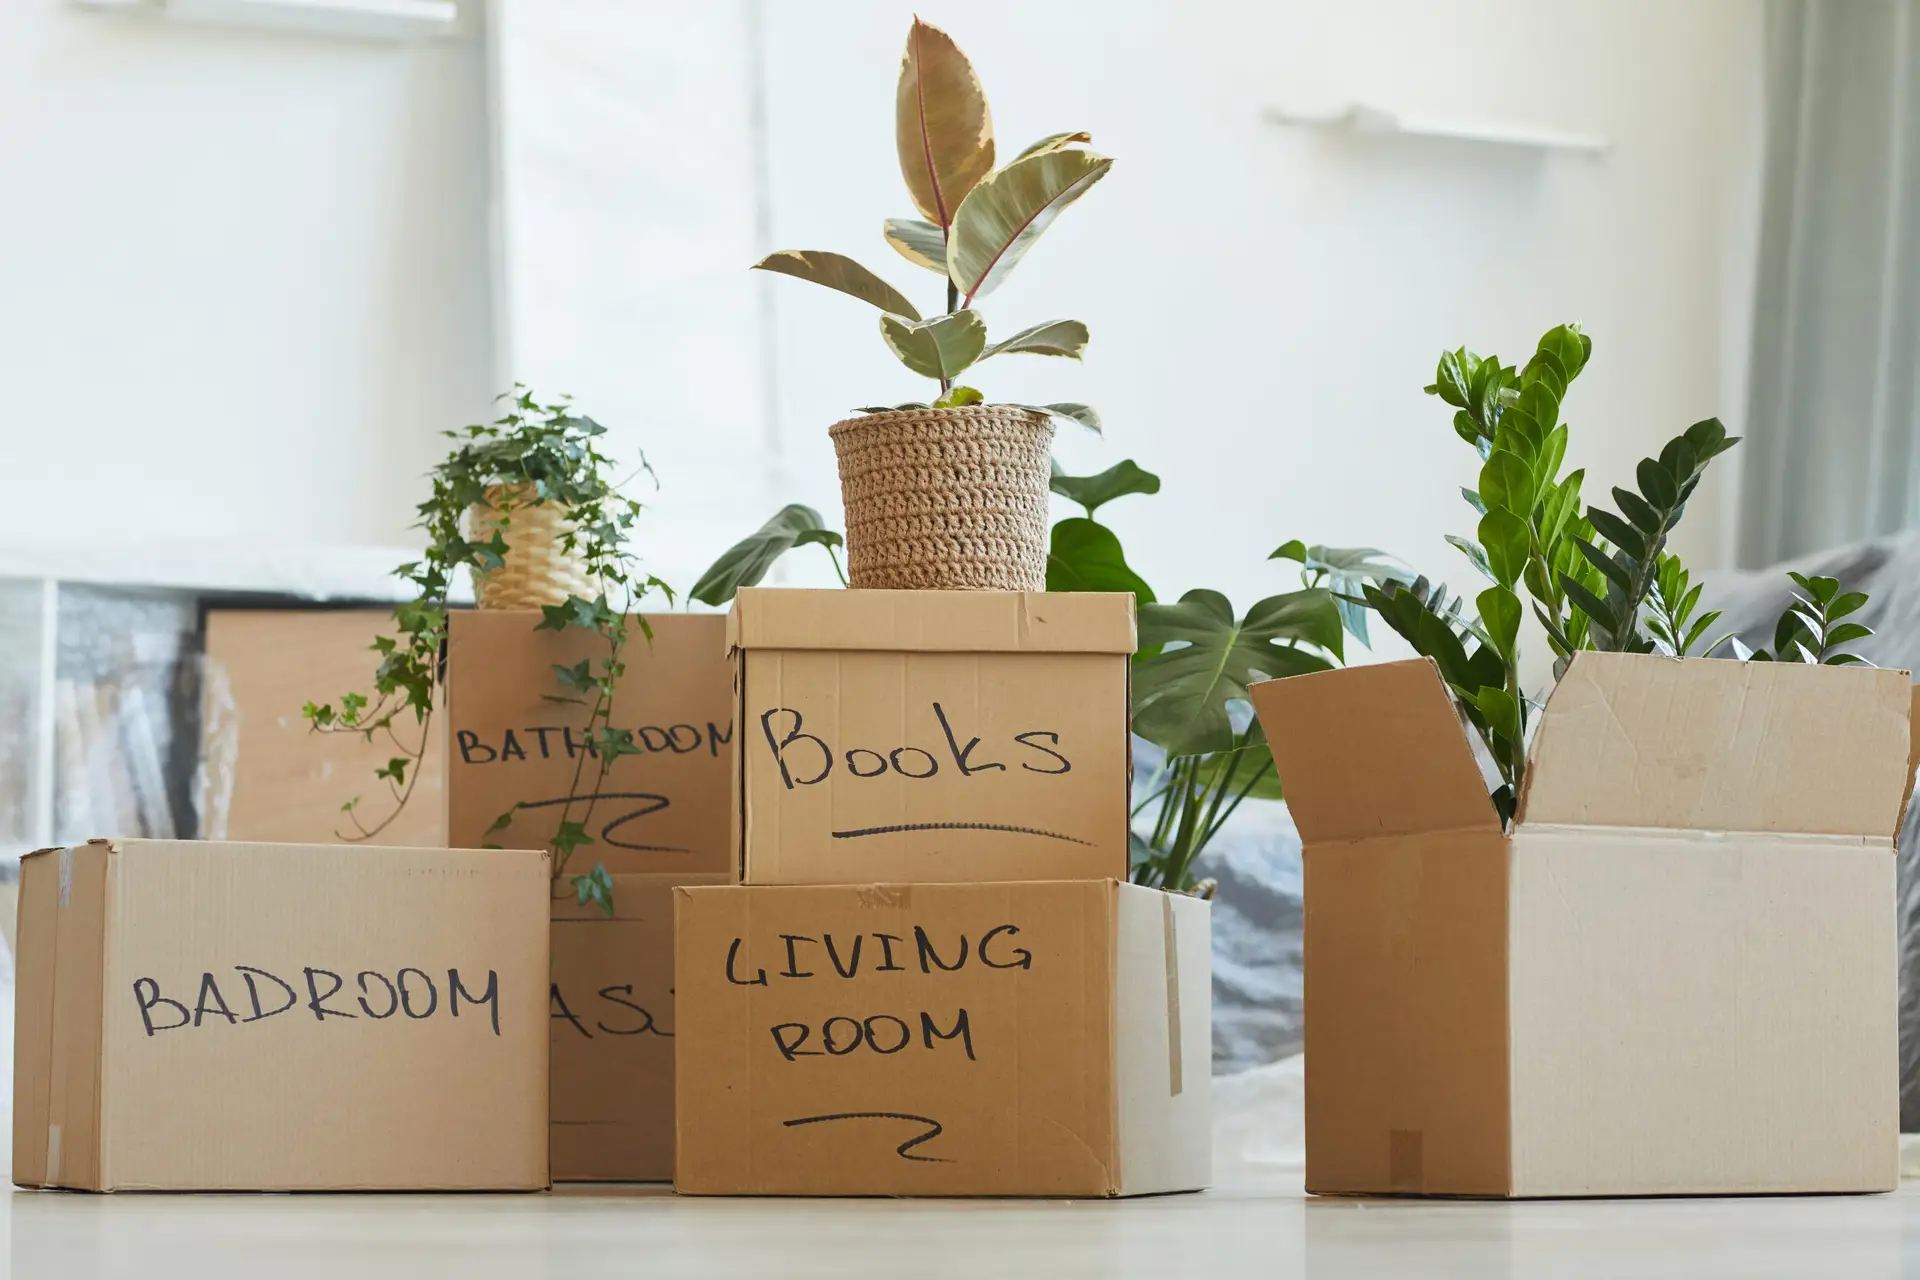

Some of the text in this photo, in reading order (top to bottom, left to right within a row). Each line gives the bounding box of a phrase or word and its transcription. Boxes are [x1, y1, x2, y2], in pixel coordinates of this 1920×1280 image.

[457, 717, 733, 765] BATHOOM
[761, 703, 1071, 790] Books
[725, 925, 1032, 987] LIVING
[133, 966, 501, 1037] BADROOM
[771, 1008, 977, 1062] ROOM
